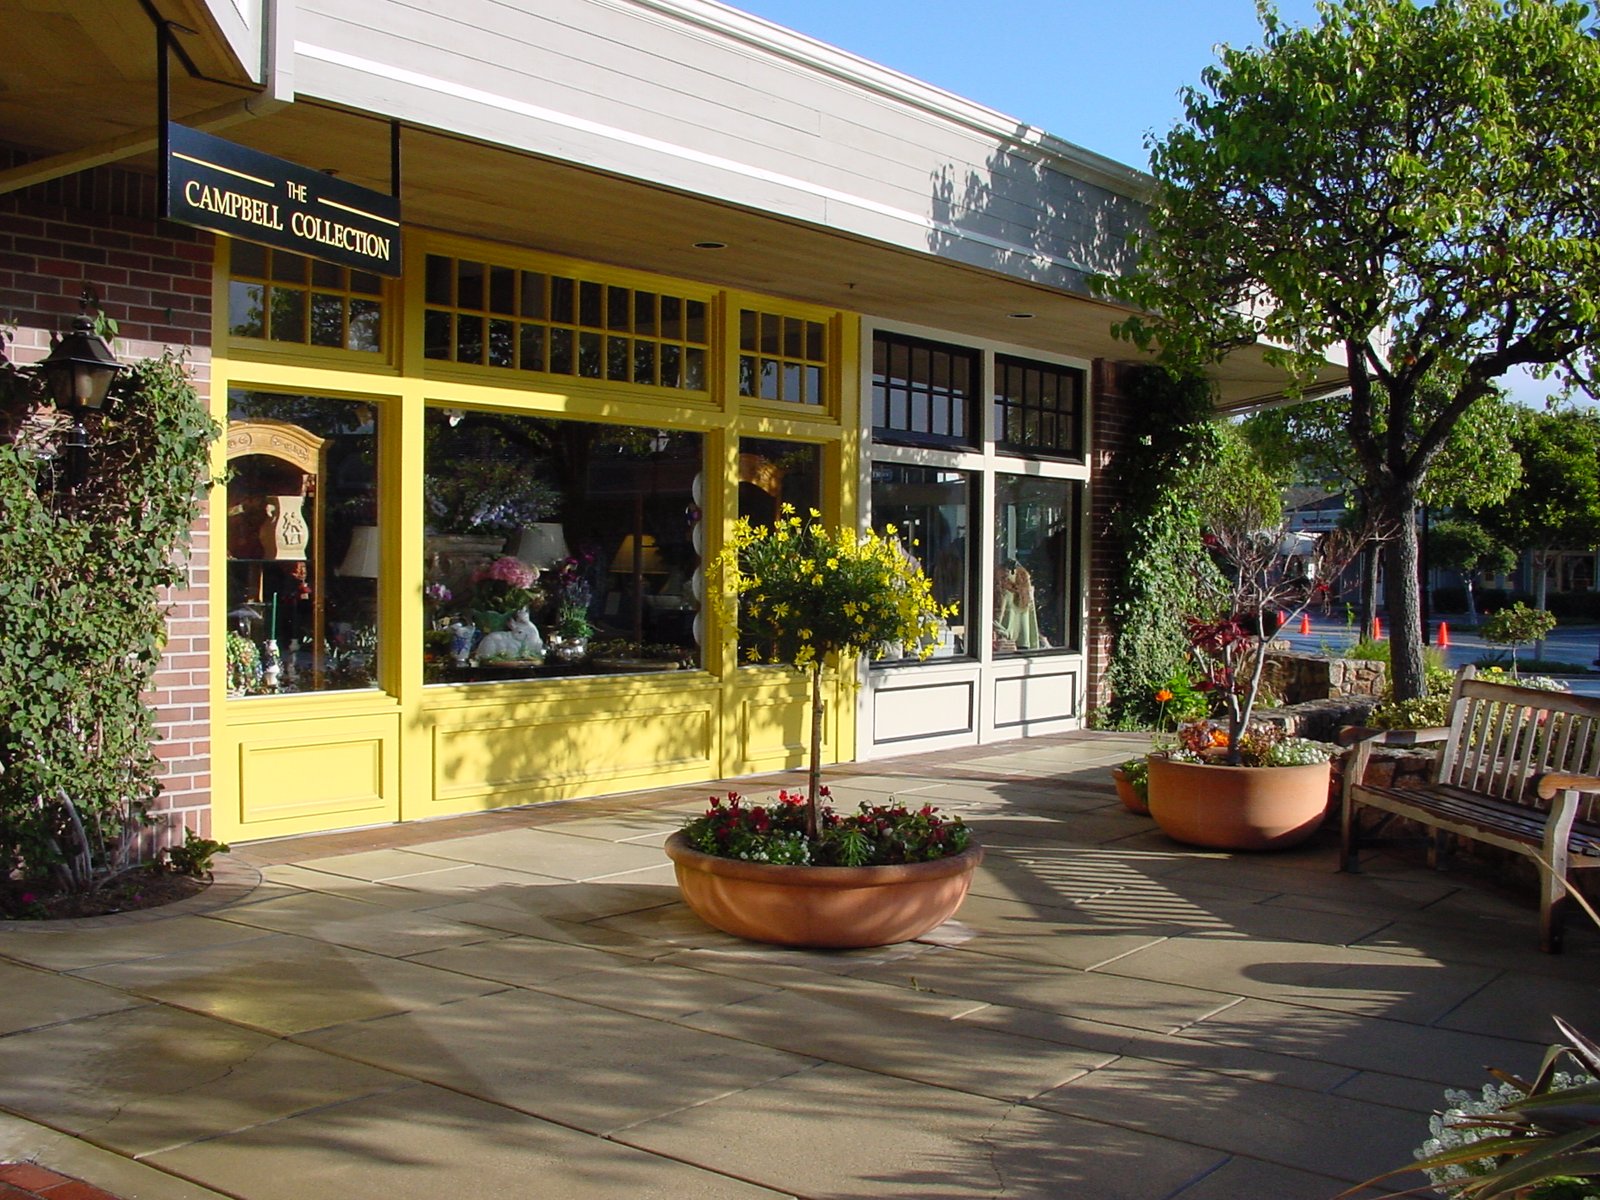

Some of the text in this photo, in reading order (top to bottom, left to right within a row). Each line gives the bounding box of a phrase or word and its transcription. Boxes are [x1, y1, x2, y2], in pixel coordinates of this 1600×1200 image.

[286, 180, 307, 203] THE
[185, 180, 390, 261] CAMPBELL COLLECTION
